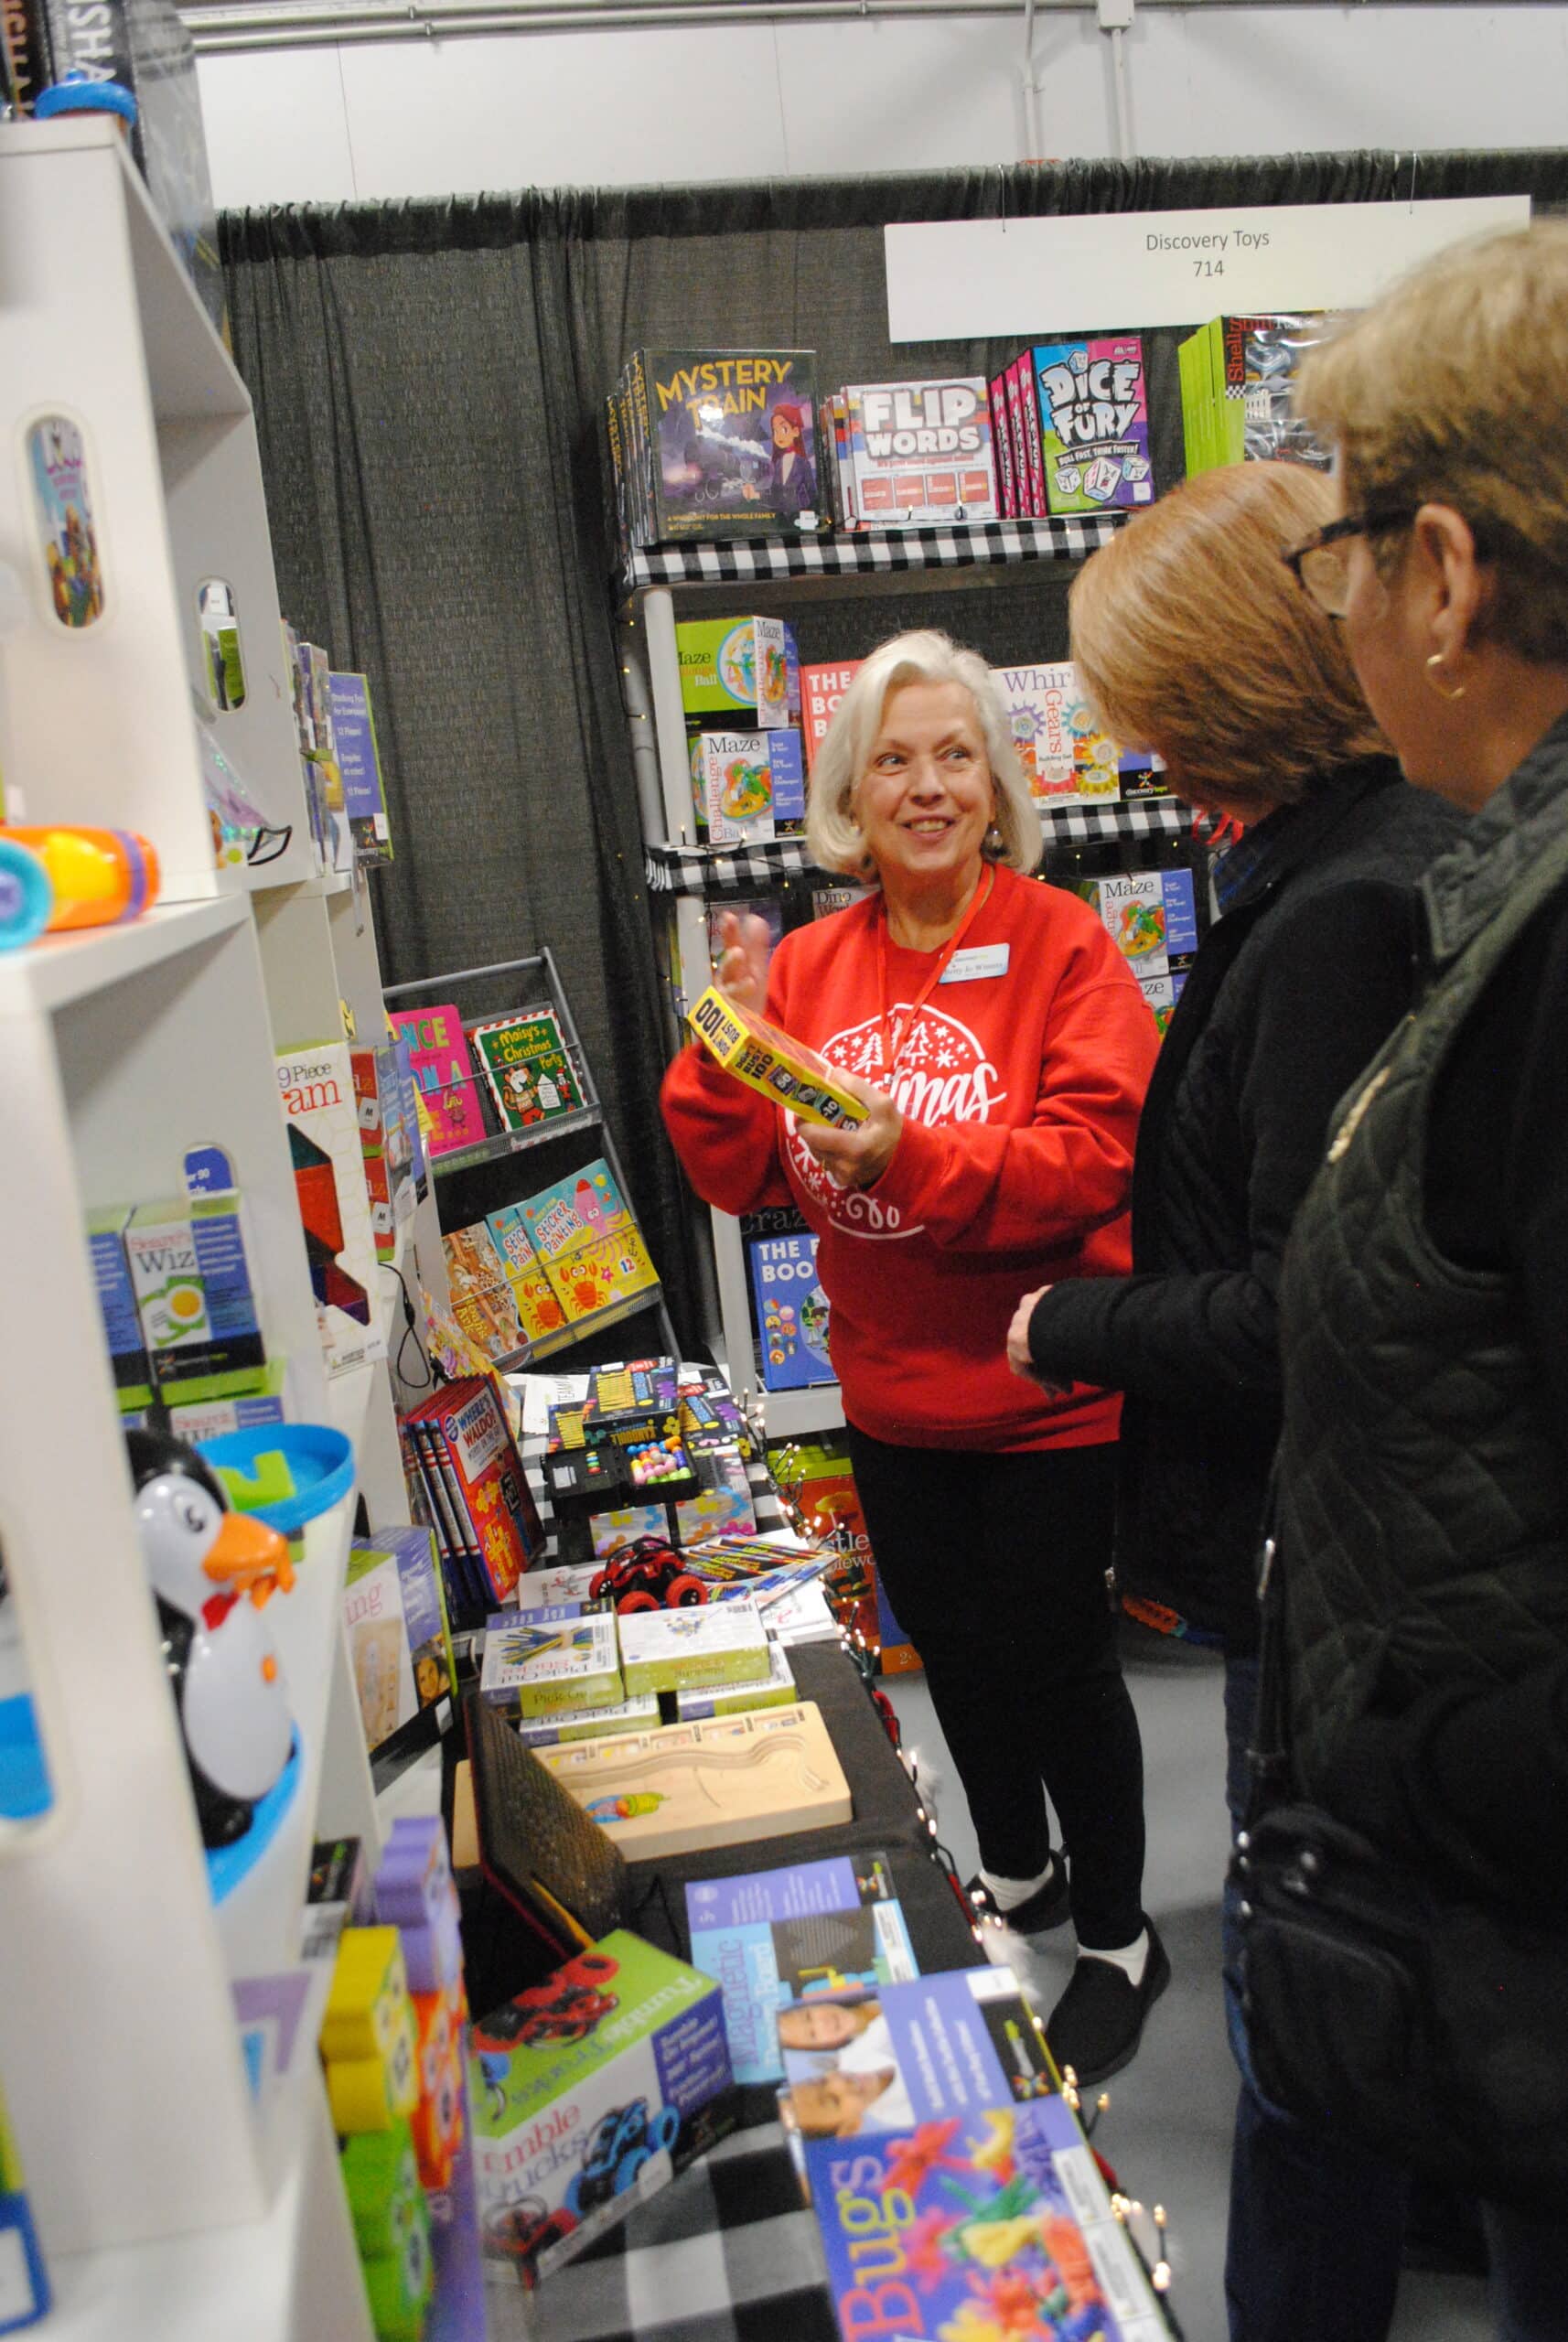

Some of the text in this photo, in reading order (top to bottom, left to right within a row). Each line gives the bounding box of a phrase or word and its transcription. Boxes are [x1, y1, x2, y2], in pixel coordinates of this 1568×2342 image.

[1146, 231, 1270, 251] Discovery Toys
[1193, 260, 1225, 276] 714
[655, 360, 792, 411] MYSTERY
[686, 387, 767, 429] TRAIN
[863, 386, 976, 431] FLIP
[1074, 403, 1090, 414] OF
[1052, 402, 1140, 446] FURY
[865, 427, 981, 457] WORDS
[757, 619, 782, 640] Maze
[694, 674, 718, 686] Ball
[809, 671, 852, 692] THE
[1045, 690, 1064, 754] Gears
[707, 736, 761, 756] Maze
[710, 756, 724, 842] Challenge
[817, 890, 852, 905] Dino
[1105, 879, 1155, 899] Maze
[695, 997, 725, 1037] 100
[499, 1025, 540, 1046] Maisy's
[722, 1020, 740, 1044] BUST
[503, 1039, 553, 1062] Christmas
[538, 1053, 564, 1069] Party
[743, 1049, 762, 1074] BUST
[293, 1063, 332, 1082] Piece
[751, 1053, 774, 1080] 100
[283, 1080, 343, 1115] am
[135, 1249, 195, 1275] Wiz
[758, 1242, 800, 1261] THE
[620, 1258, 637, 1273] 12
[457, 1393, 491, 1432] WHERE'S
[345, 1583, 382, 1625] ing
[718, 1939, 763, 2068] Magnetic
[831, 2155, 926, 2342] Bugs
